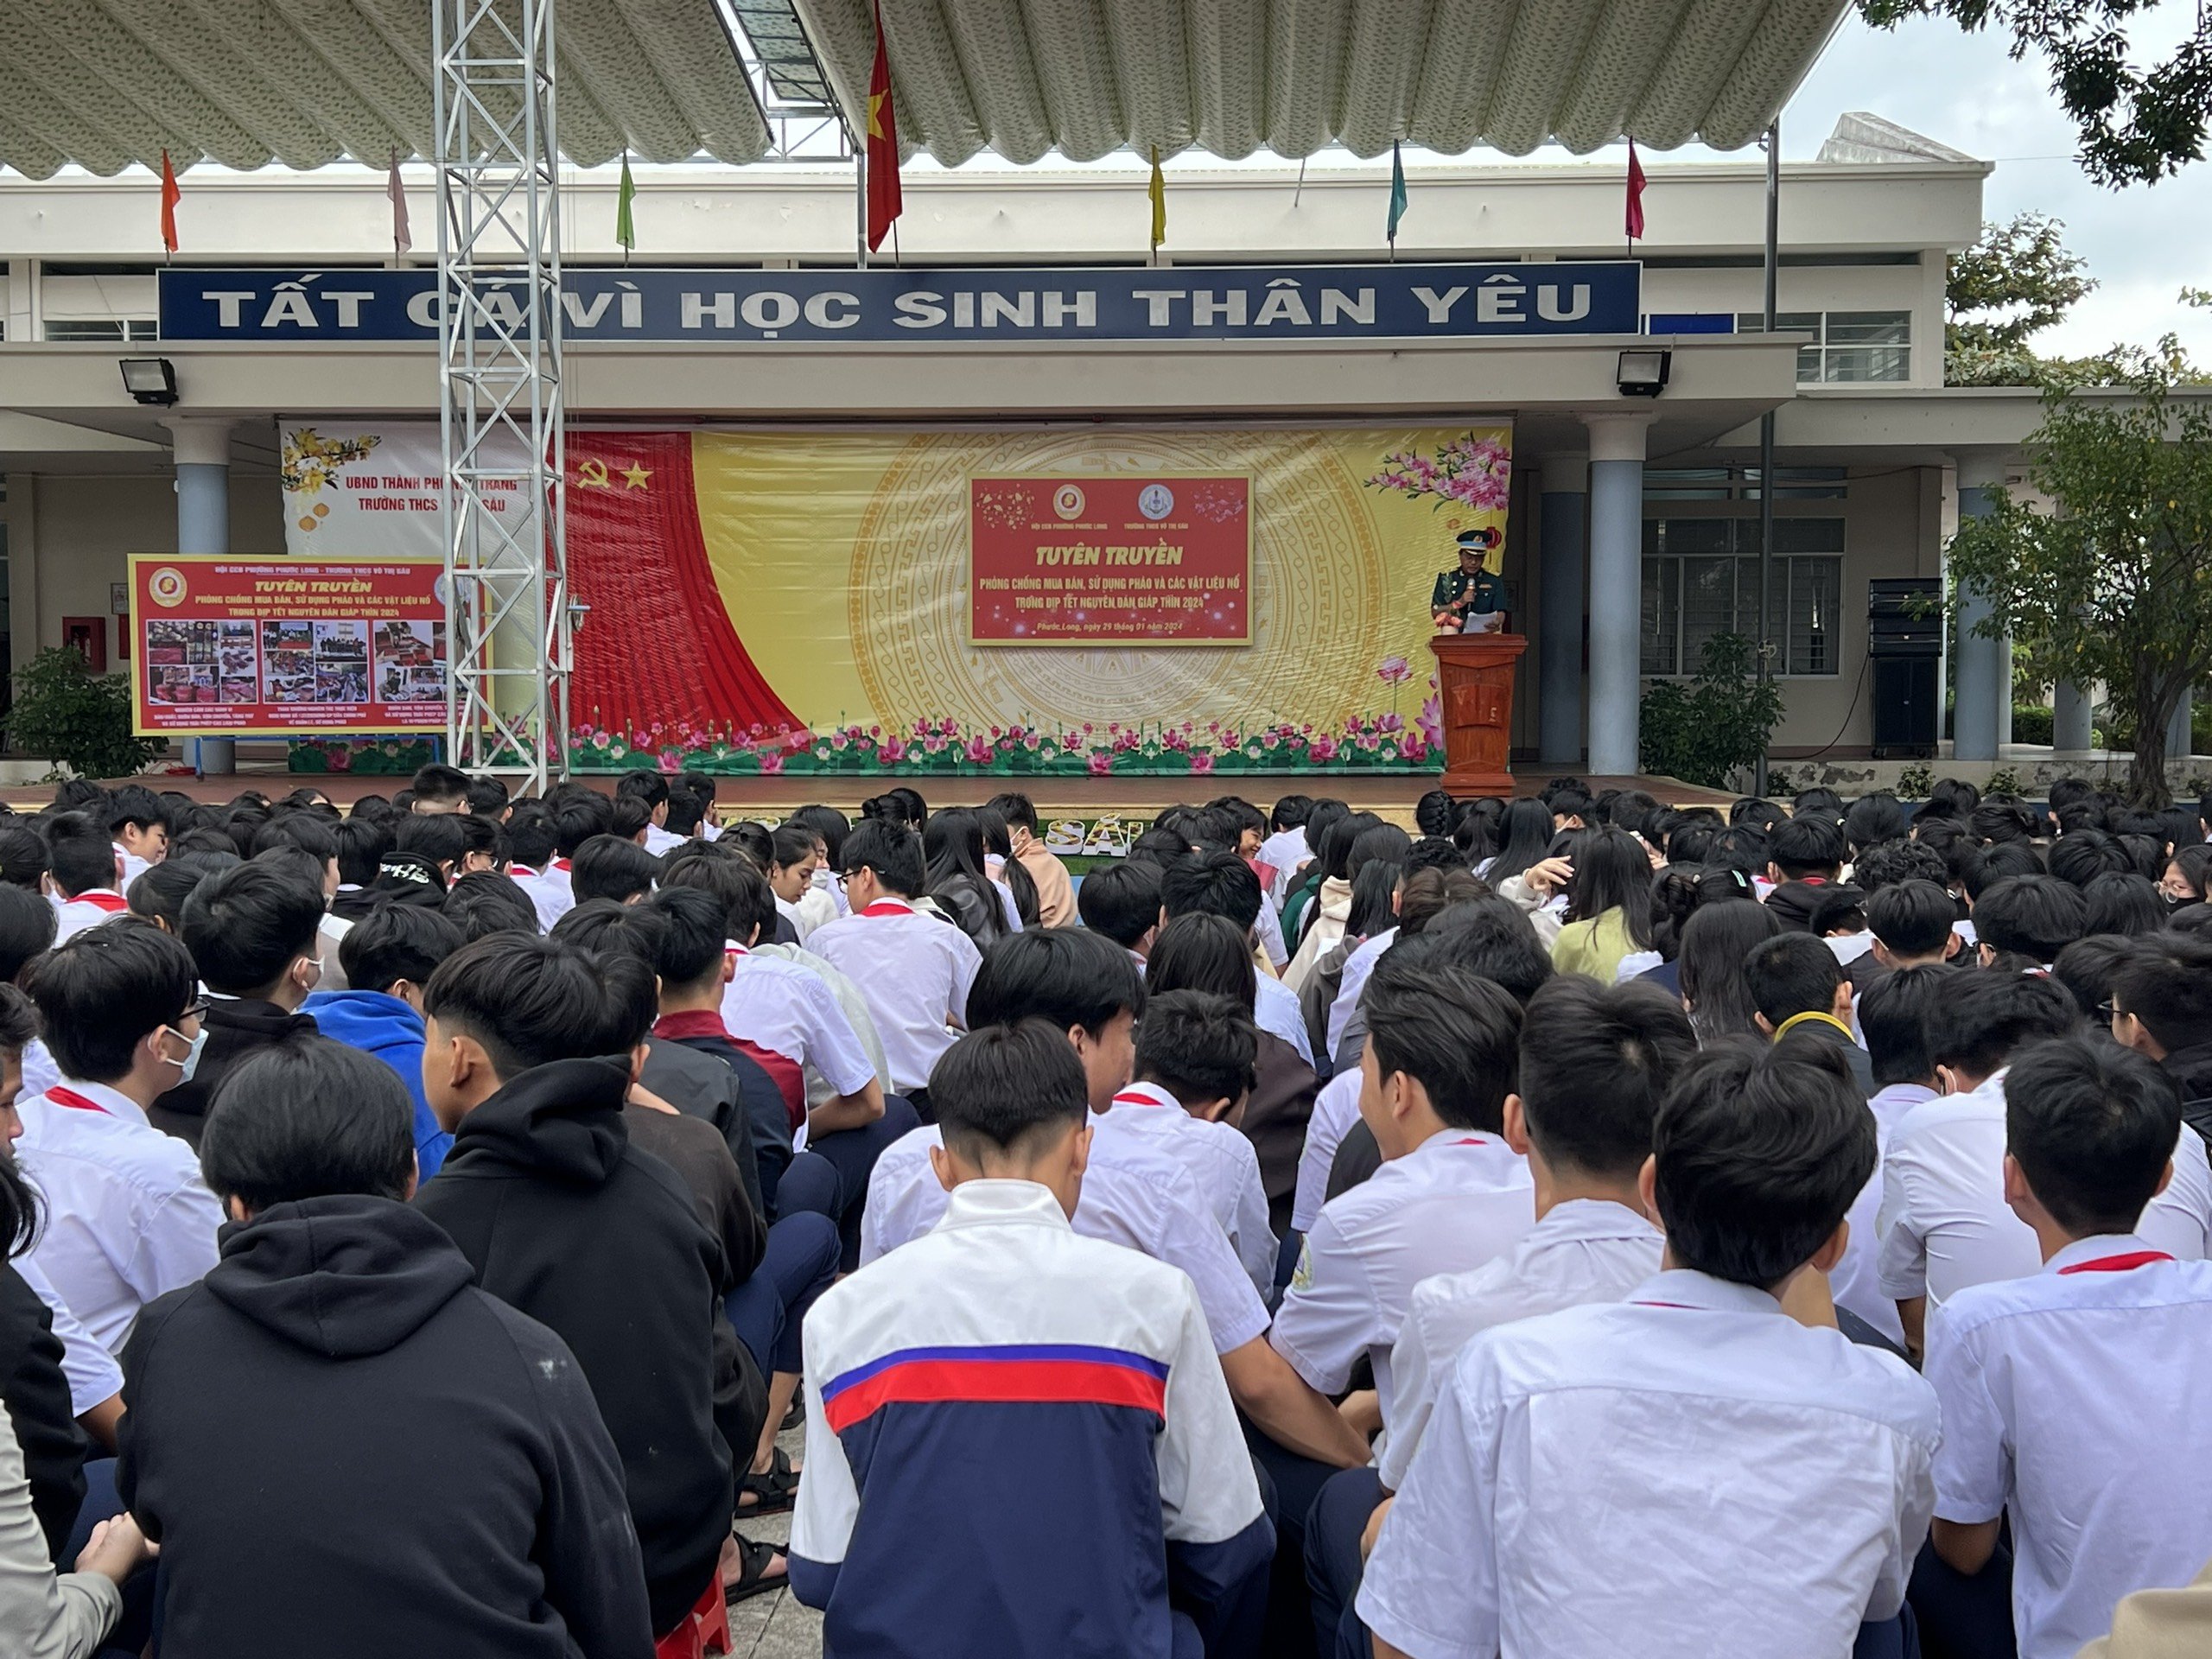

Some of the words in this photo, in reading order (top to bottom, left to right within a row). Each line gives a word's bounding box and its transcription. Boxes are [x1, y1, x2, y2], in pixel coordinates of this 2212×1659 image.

[202, 274, 374, 327] TẤT
[561, 281, 642, 327] VÌ
[681, 291, 861, 338] HỌC
[892, 291, 1096, 327] SINH
[1132, 278, 1376, 326] THÂN
[1410, 273, 1591, 324] YÊU
[346, 476, 378, 489] UBND
[381, 474, 420, 490] THÀNH
[424, 477, 443, 490] PH
[480, 479, 518, 491] TRANG
[359, 495, 405, 511] TRƯỜNG
[409, 499, 438, 512] THCS
[1036, 542, 1101, 565] TUYÊN
[1105, 537, 1184, 565] TRUYỀN
[255, 579, 307, 592] TUYÊN
[311, 577, 372, 592] TRUYỀN
[980, 575, 1009, 589] PHÒNG
[1012, 575, 1041, 589] CHỐNG
[1043, 578, 1063, 589] MUA
[1128, 575, 1152, 589] PHÁO
[1154, 575, 1166, 589] VÀ
[1167, 575, 1185, 589] CÁC
[1187, 575, 1204, 591] VẬT
[1205, 575, 1224, 591] LIỆU
[1015, 596, 1044, 608] TRONG
[1046, 597, 1061, 610] DỊP
[1063, 594, 1077, 608] TẾT
[1080, 594, 1116, 608] NGUYÊN
[1137, 594, 1158, 608] GIÁP
[1182, 596, 1204, 608] 2024
